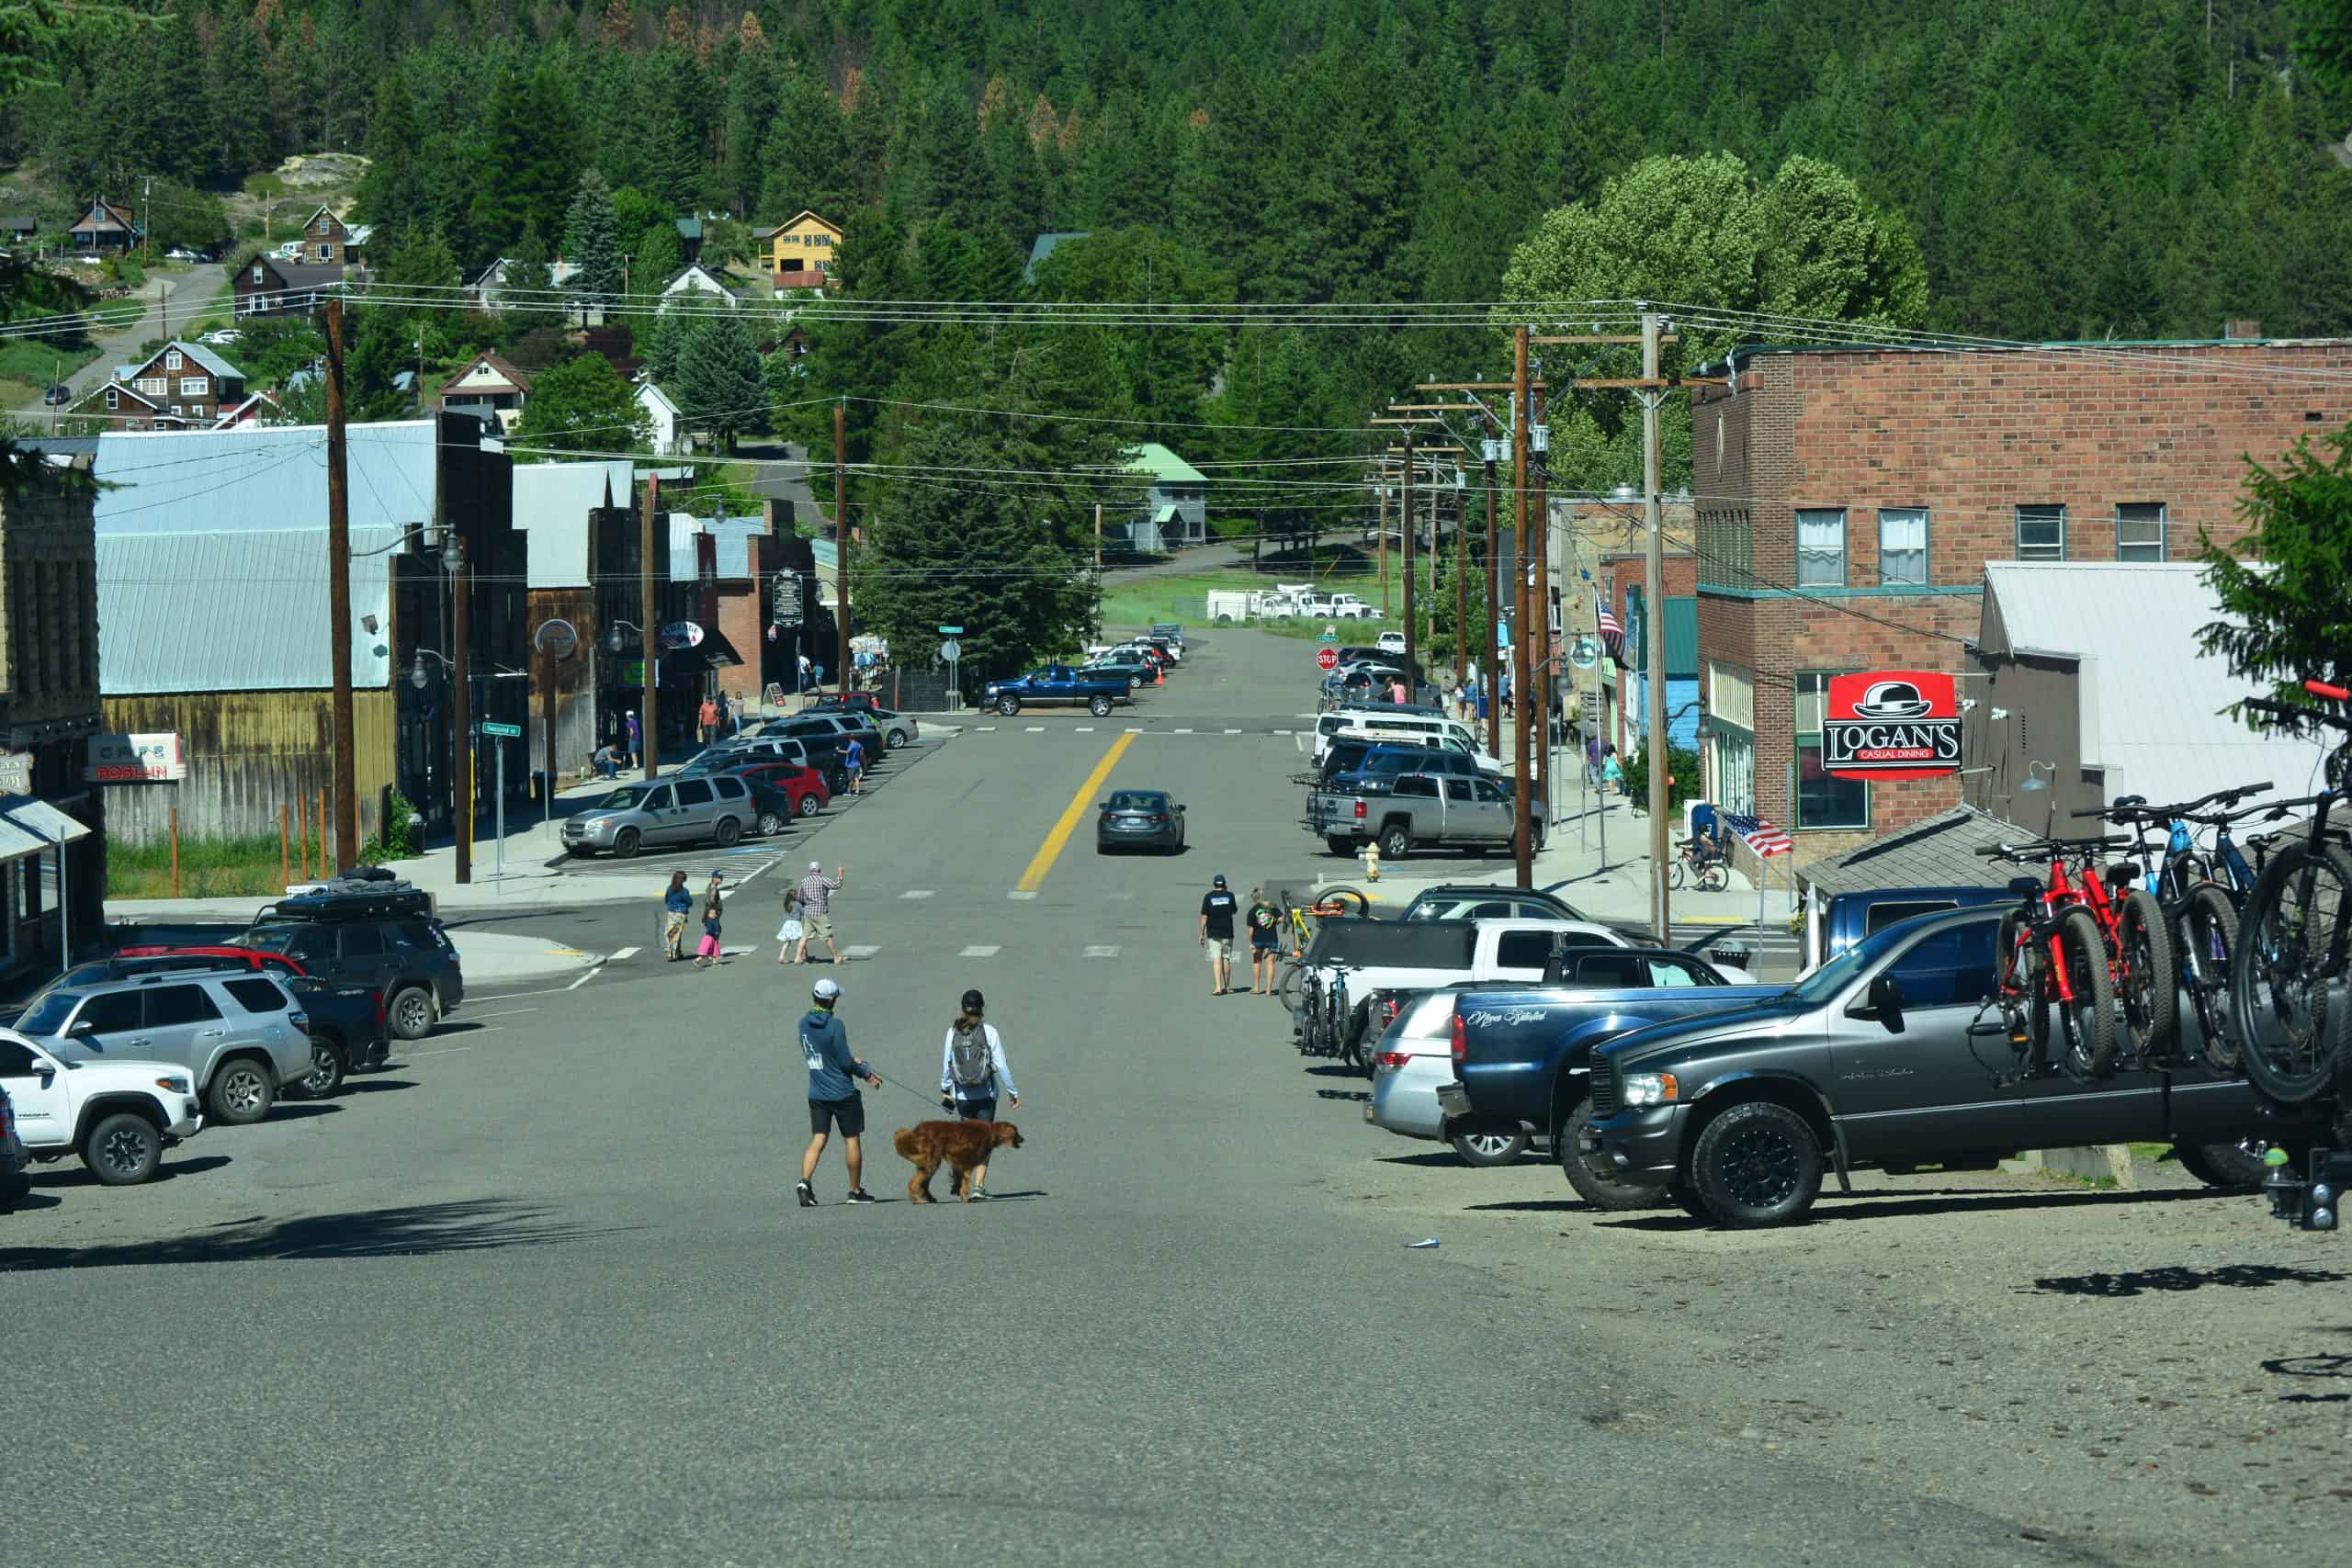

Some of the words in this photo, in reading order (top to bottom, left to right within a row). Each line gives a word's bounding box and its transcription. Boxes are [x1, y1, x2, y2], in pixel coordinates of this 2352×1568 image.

[1317, 655, 1337, 664] STOP
[1826, 724, 1959, 761] LOGAN'S
[1860, 750, 1896, 759] CASUAL
[1897, 749, 1929, 759] DINING
[96, 764, 168, 780] ROSLYN
